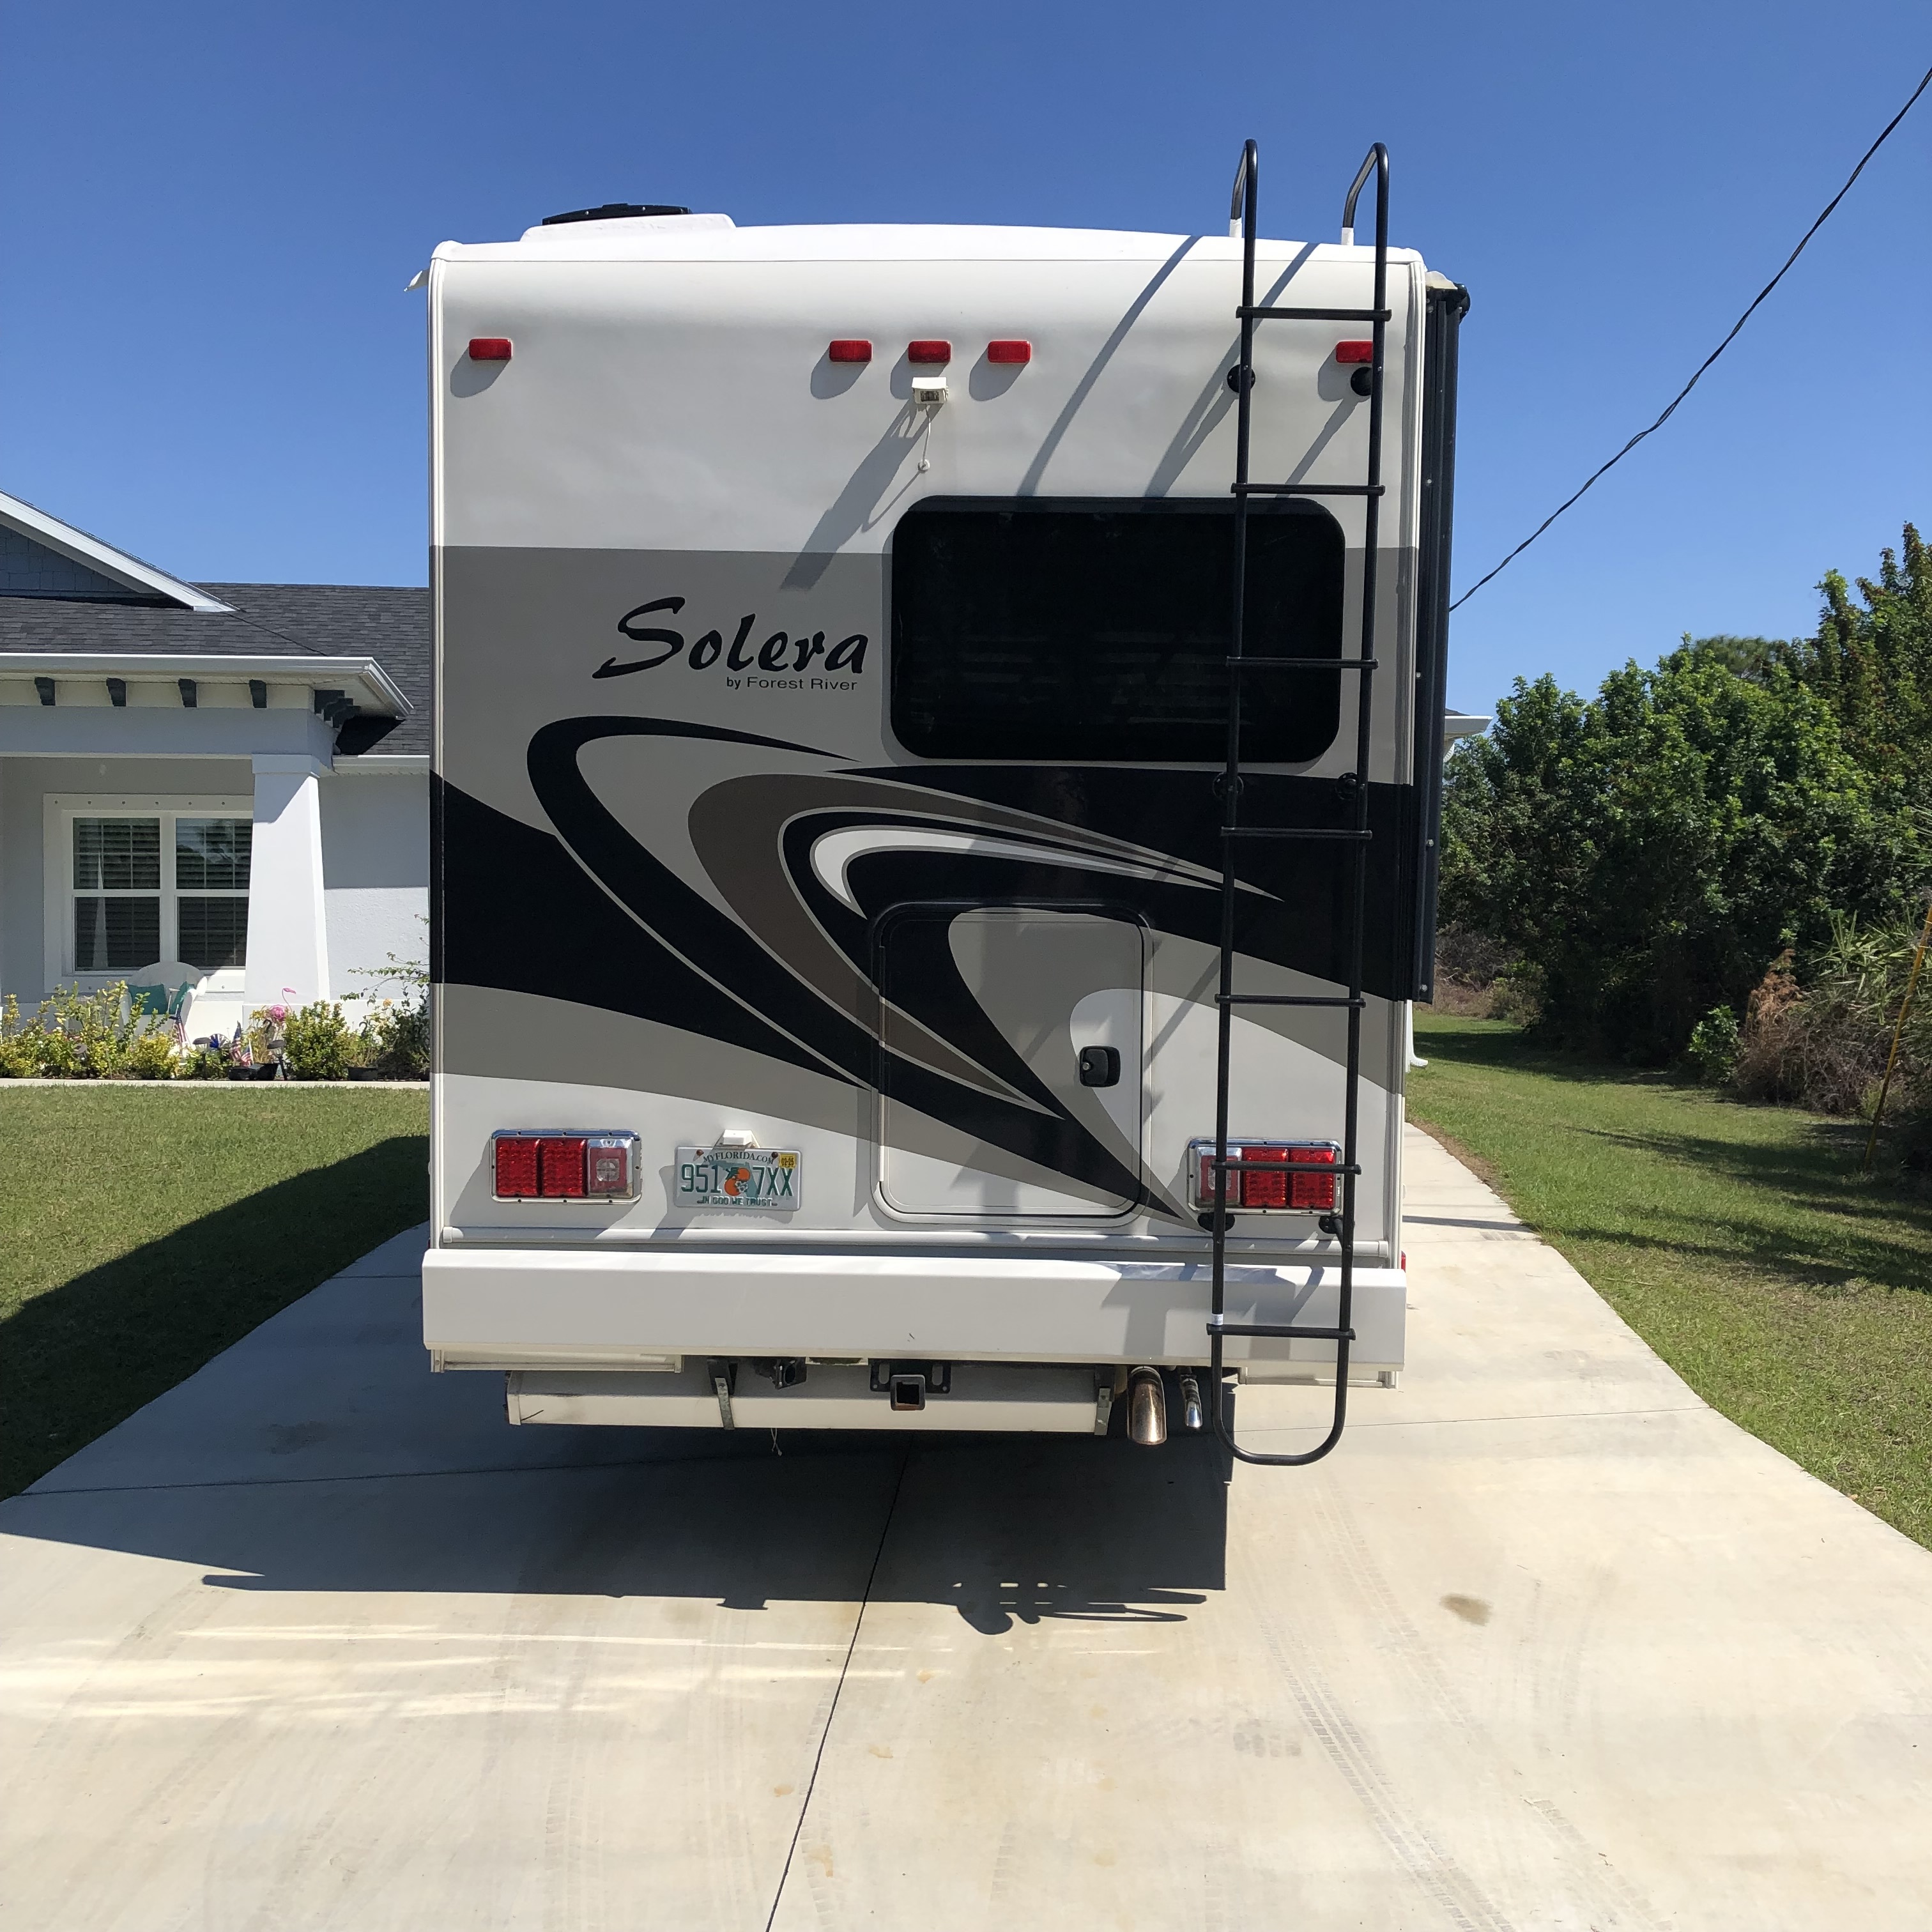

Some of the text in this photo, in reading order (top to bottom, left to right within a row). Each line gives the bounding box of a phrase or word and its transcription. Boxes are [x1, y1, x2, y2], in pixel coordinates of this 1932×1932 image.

[592, 596, 869, 678] Solera
[726, 676, 857, 691] by Forest River
[681, 1163, 794, 1197] 951 7XX
[703, 1195, 773, 1206] IN GOD WE TRUST
